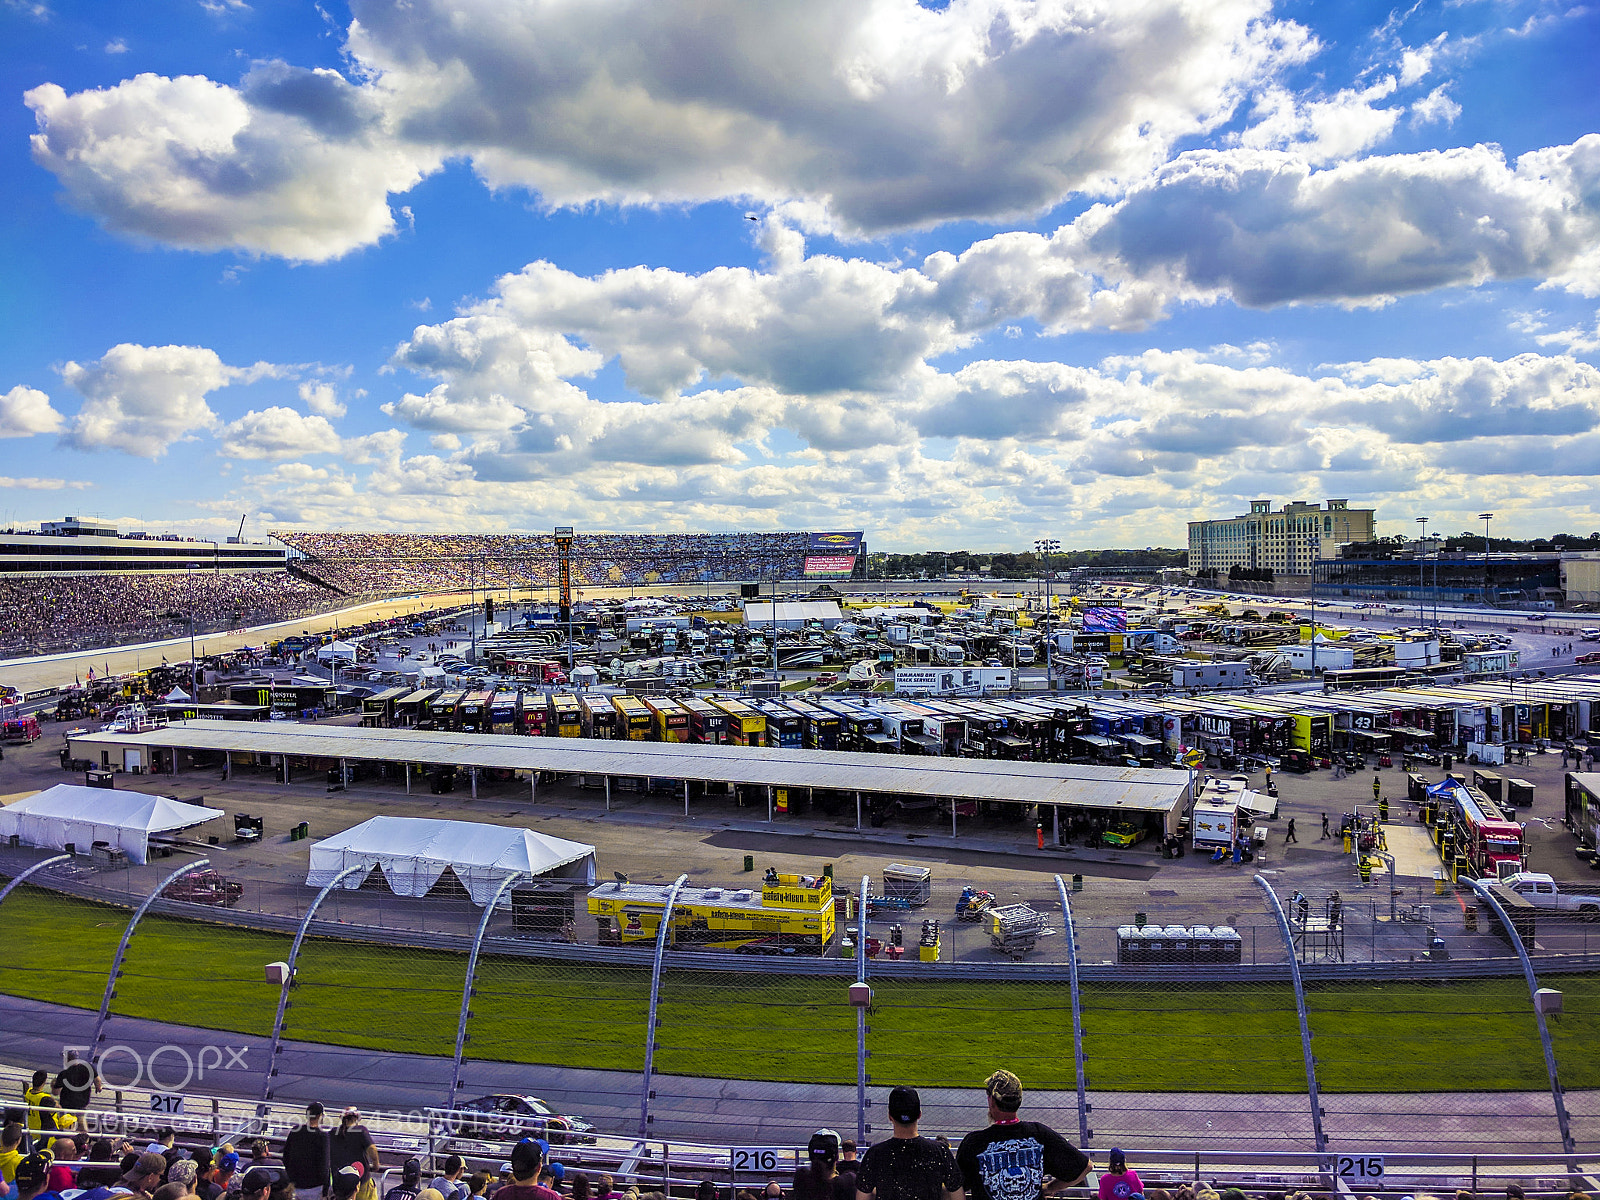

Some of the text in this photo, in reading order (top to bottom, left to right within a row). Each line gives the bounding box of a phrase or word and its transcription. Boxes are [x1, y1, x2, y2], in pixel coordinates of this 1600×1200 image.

[1355, 716, 1372, 729] 43
[1054, 727, 1066, 742] 14
[151, 1094, 182, 1114] 217
[735, 1149, 777, 1171] 216
[1339, 1157, 1383, 1178] 215
